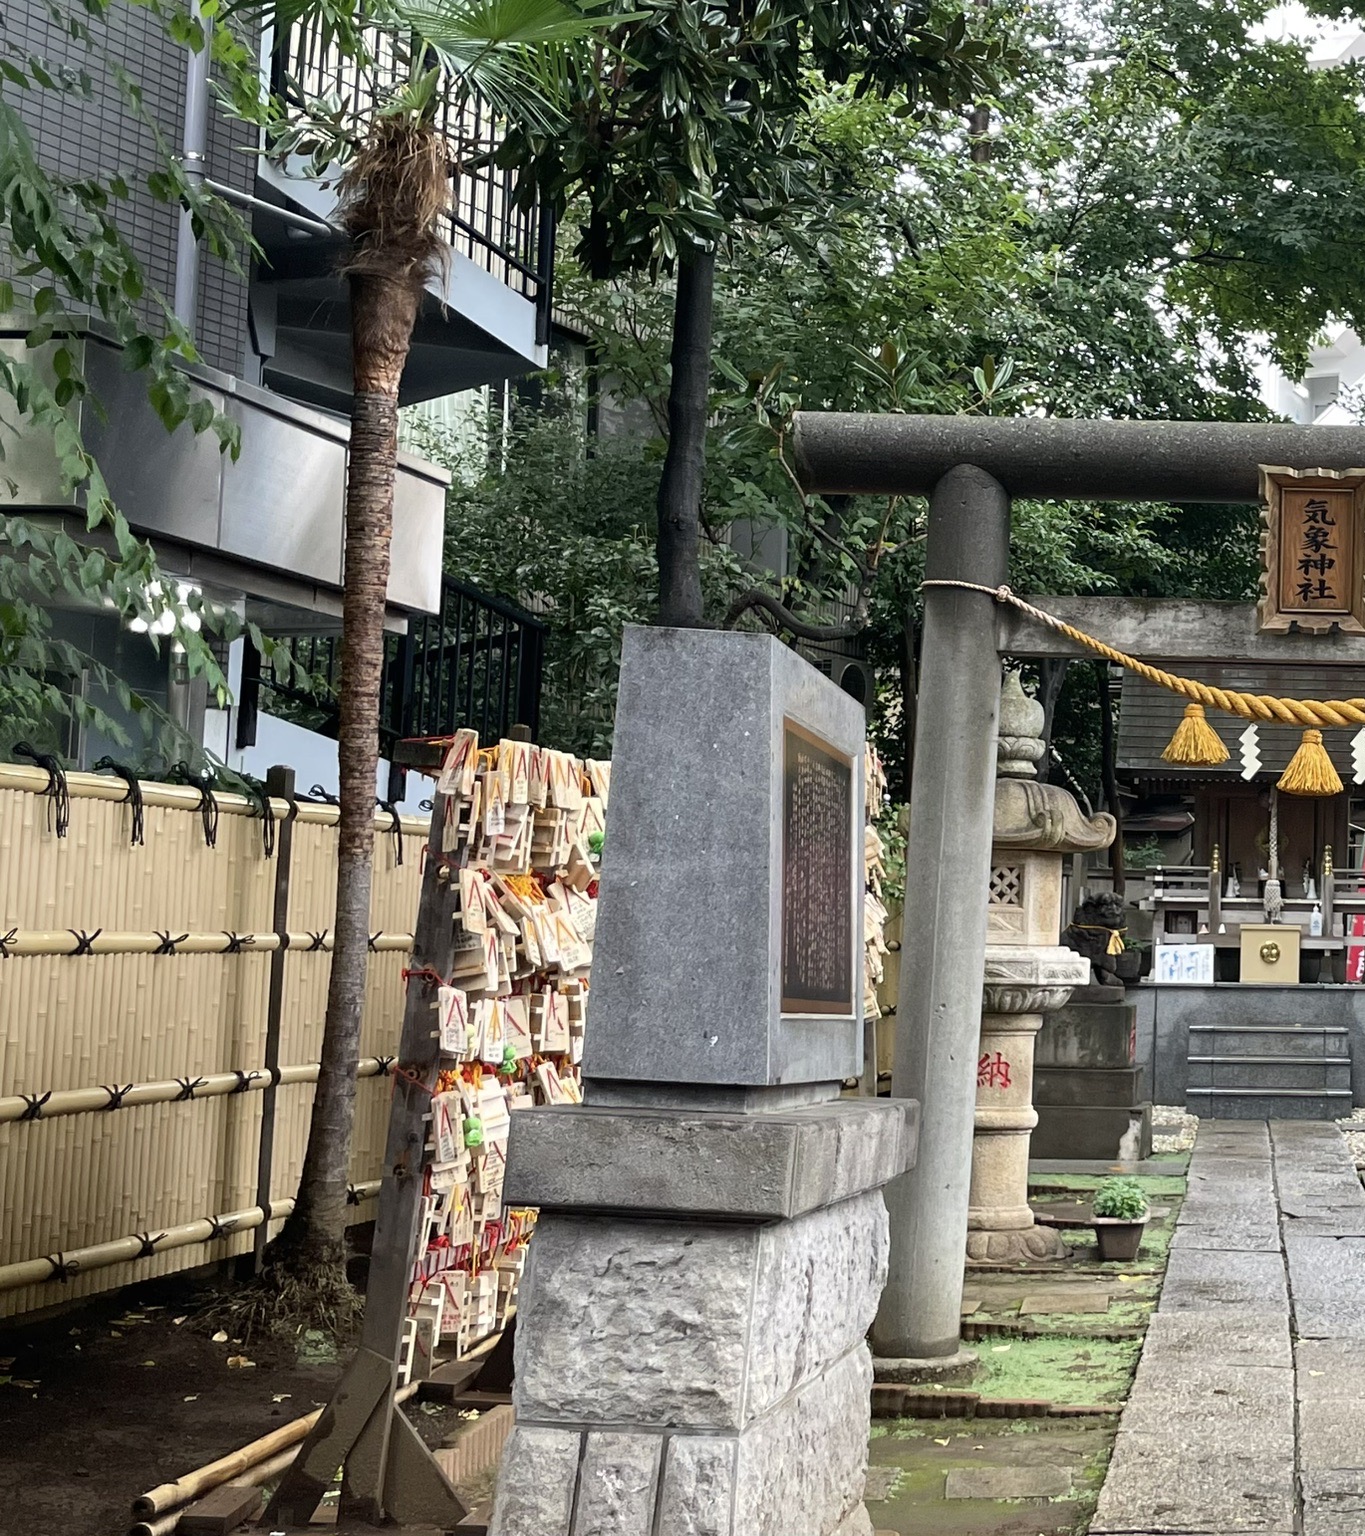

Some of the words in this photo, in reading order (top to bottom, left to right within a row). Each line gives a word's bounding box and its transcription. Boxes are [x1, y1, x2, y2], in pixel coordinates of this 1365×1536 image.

[1295, 498, 1339, 602] 気象神社
[976, 1051, 1012, 1088] 納
